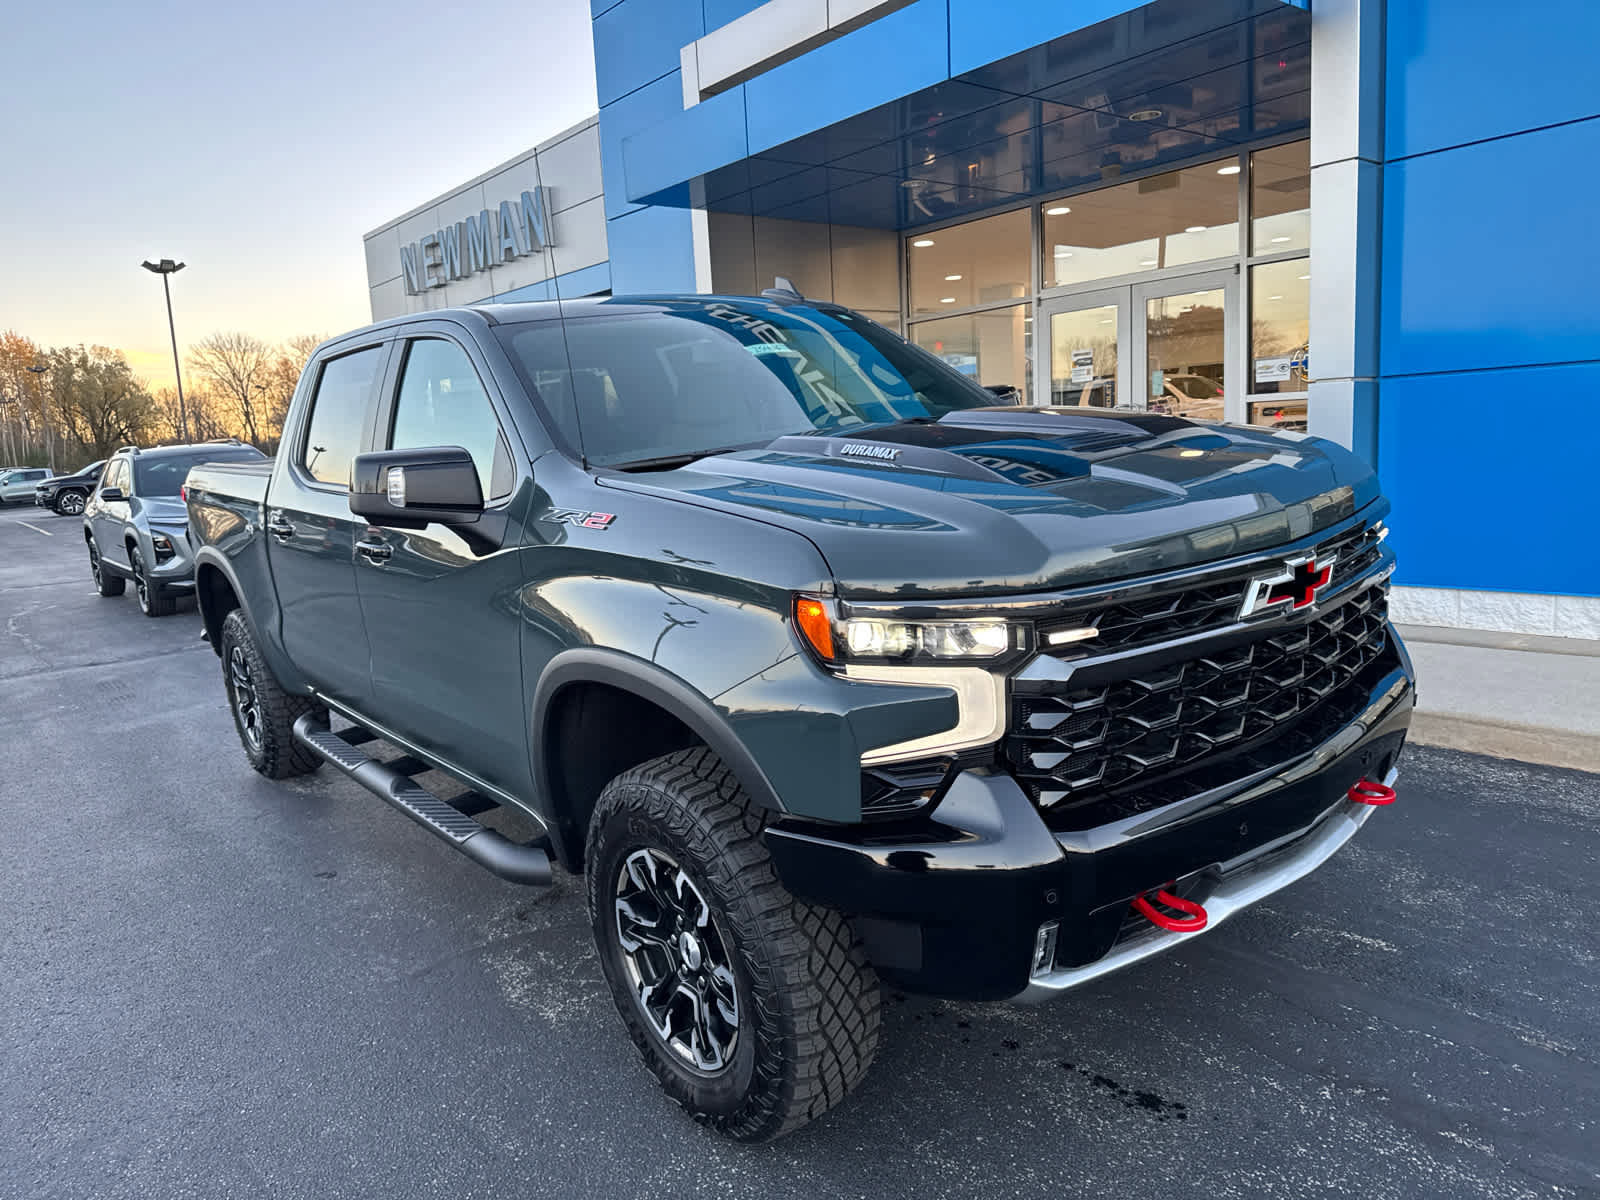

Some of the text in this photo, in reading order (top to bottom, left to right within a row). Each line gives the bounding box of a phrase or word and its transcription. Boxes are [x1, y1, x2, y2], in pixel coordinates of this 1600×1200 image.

[400, 186, 553, 296] NEWMAN
[840, 444, 902, 461] DURAMAX
[540, 507, 617, 530] ZR2
